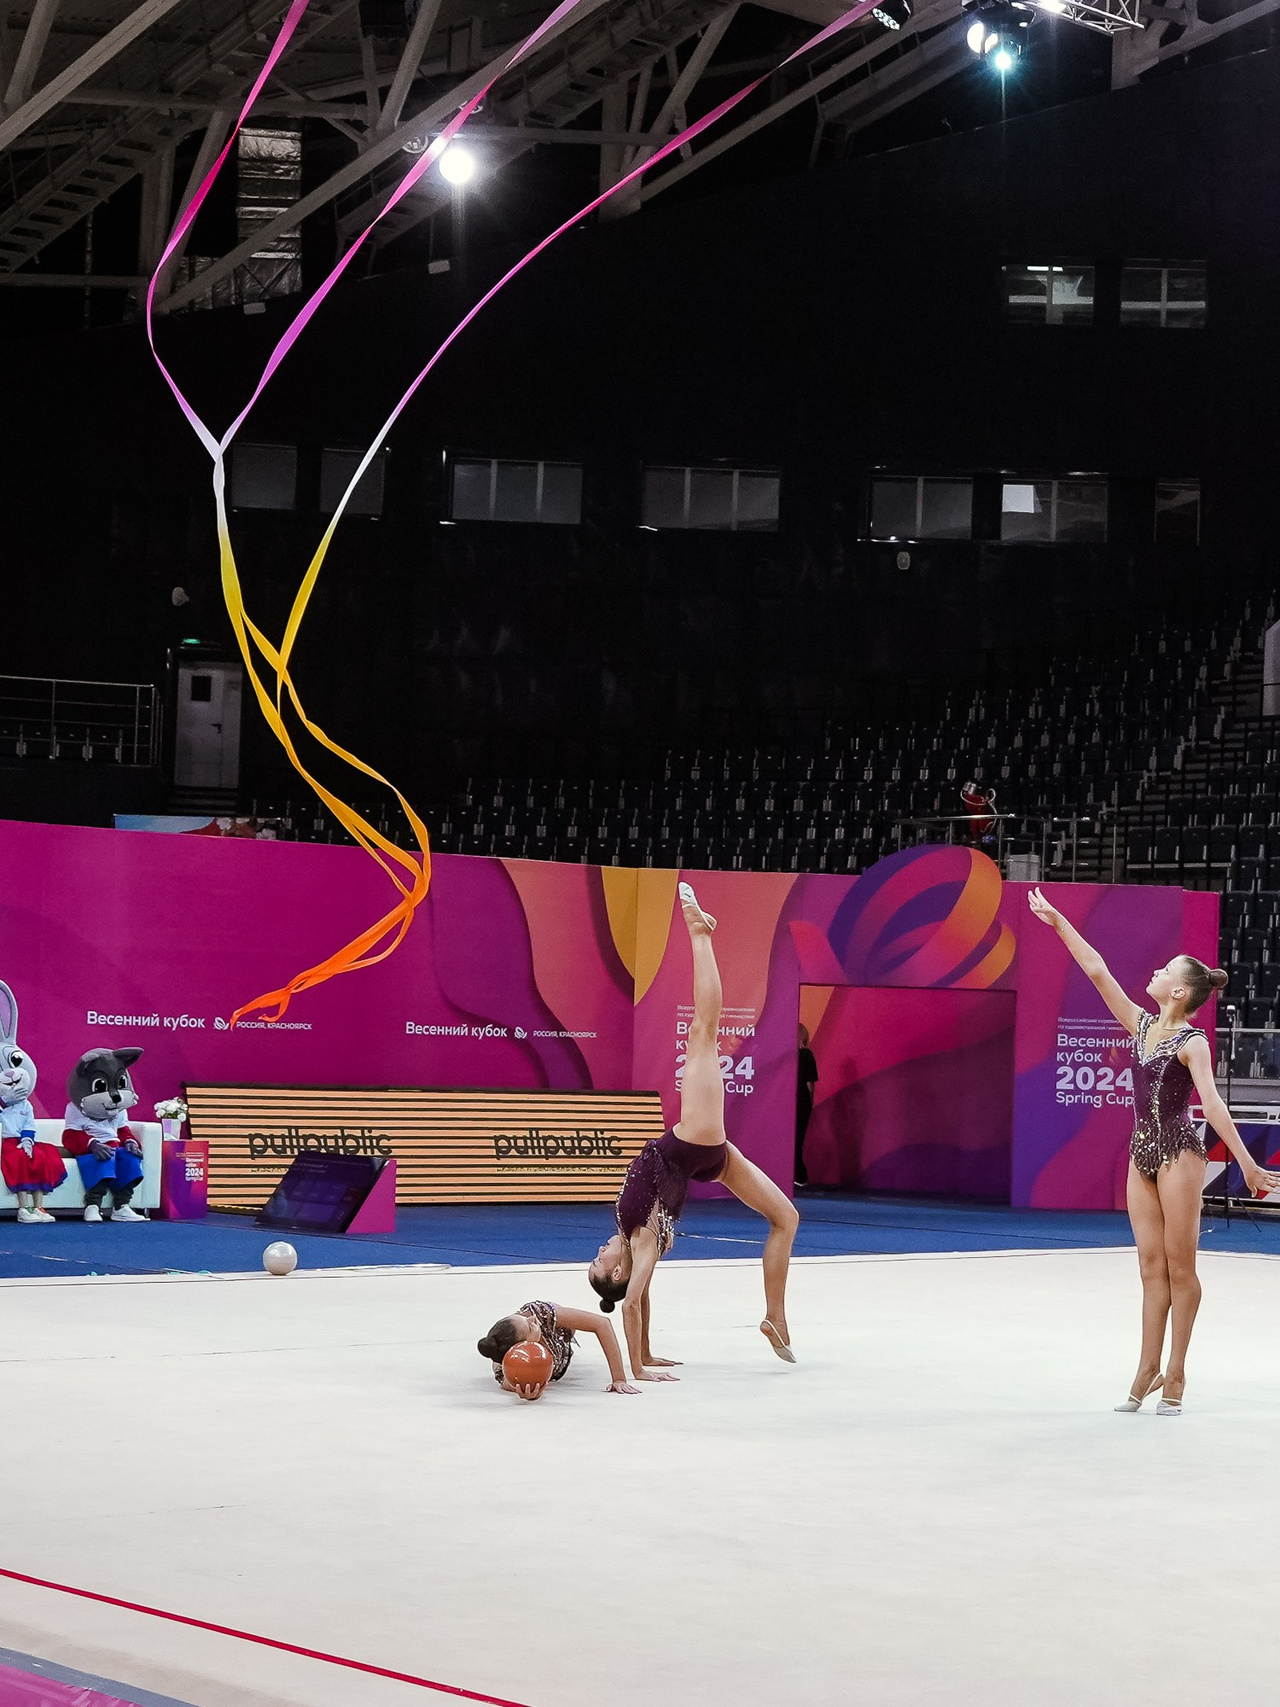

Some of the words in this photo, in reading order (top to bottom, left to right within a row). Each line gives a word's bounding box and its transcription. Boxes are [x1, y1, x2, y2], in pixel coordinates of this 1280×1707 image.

[87, 1010, 160, 1028] Весенний
[163, 1013, 206, 1031] кубок
[267, 1022, 313, 1031] КРАСНОЯРСК
[405, 1021, 469, 1037] Весенний
[471, 1024, 508, 1040] кубок
[559, 1031, 598, 1039] КРАСНОЯРСК
[676, 1021, 755, 1037] Внний
[1057, 1033, 1135, 1049] Весенний
[1056, 1049, 1103, 1065] кубок
[675, 1054, 755, 1080] 224
[1056, 1065, 1134, 1091] 2024
[725, 1081, 754, 1097] Cup
[1056, 1091, 1102, 1108] Spring
[1105, 1092, 1134, 1108] Cup
[249, 1127, 393, 1161] pullpublic
[494, 1129, 623, 1161] pullpublic
[185, 1167, 204, 1177] 2024
